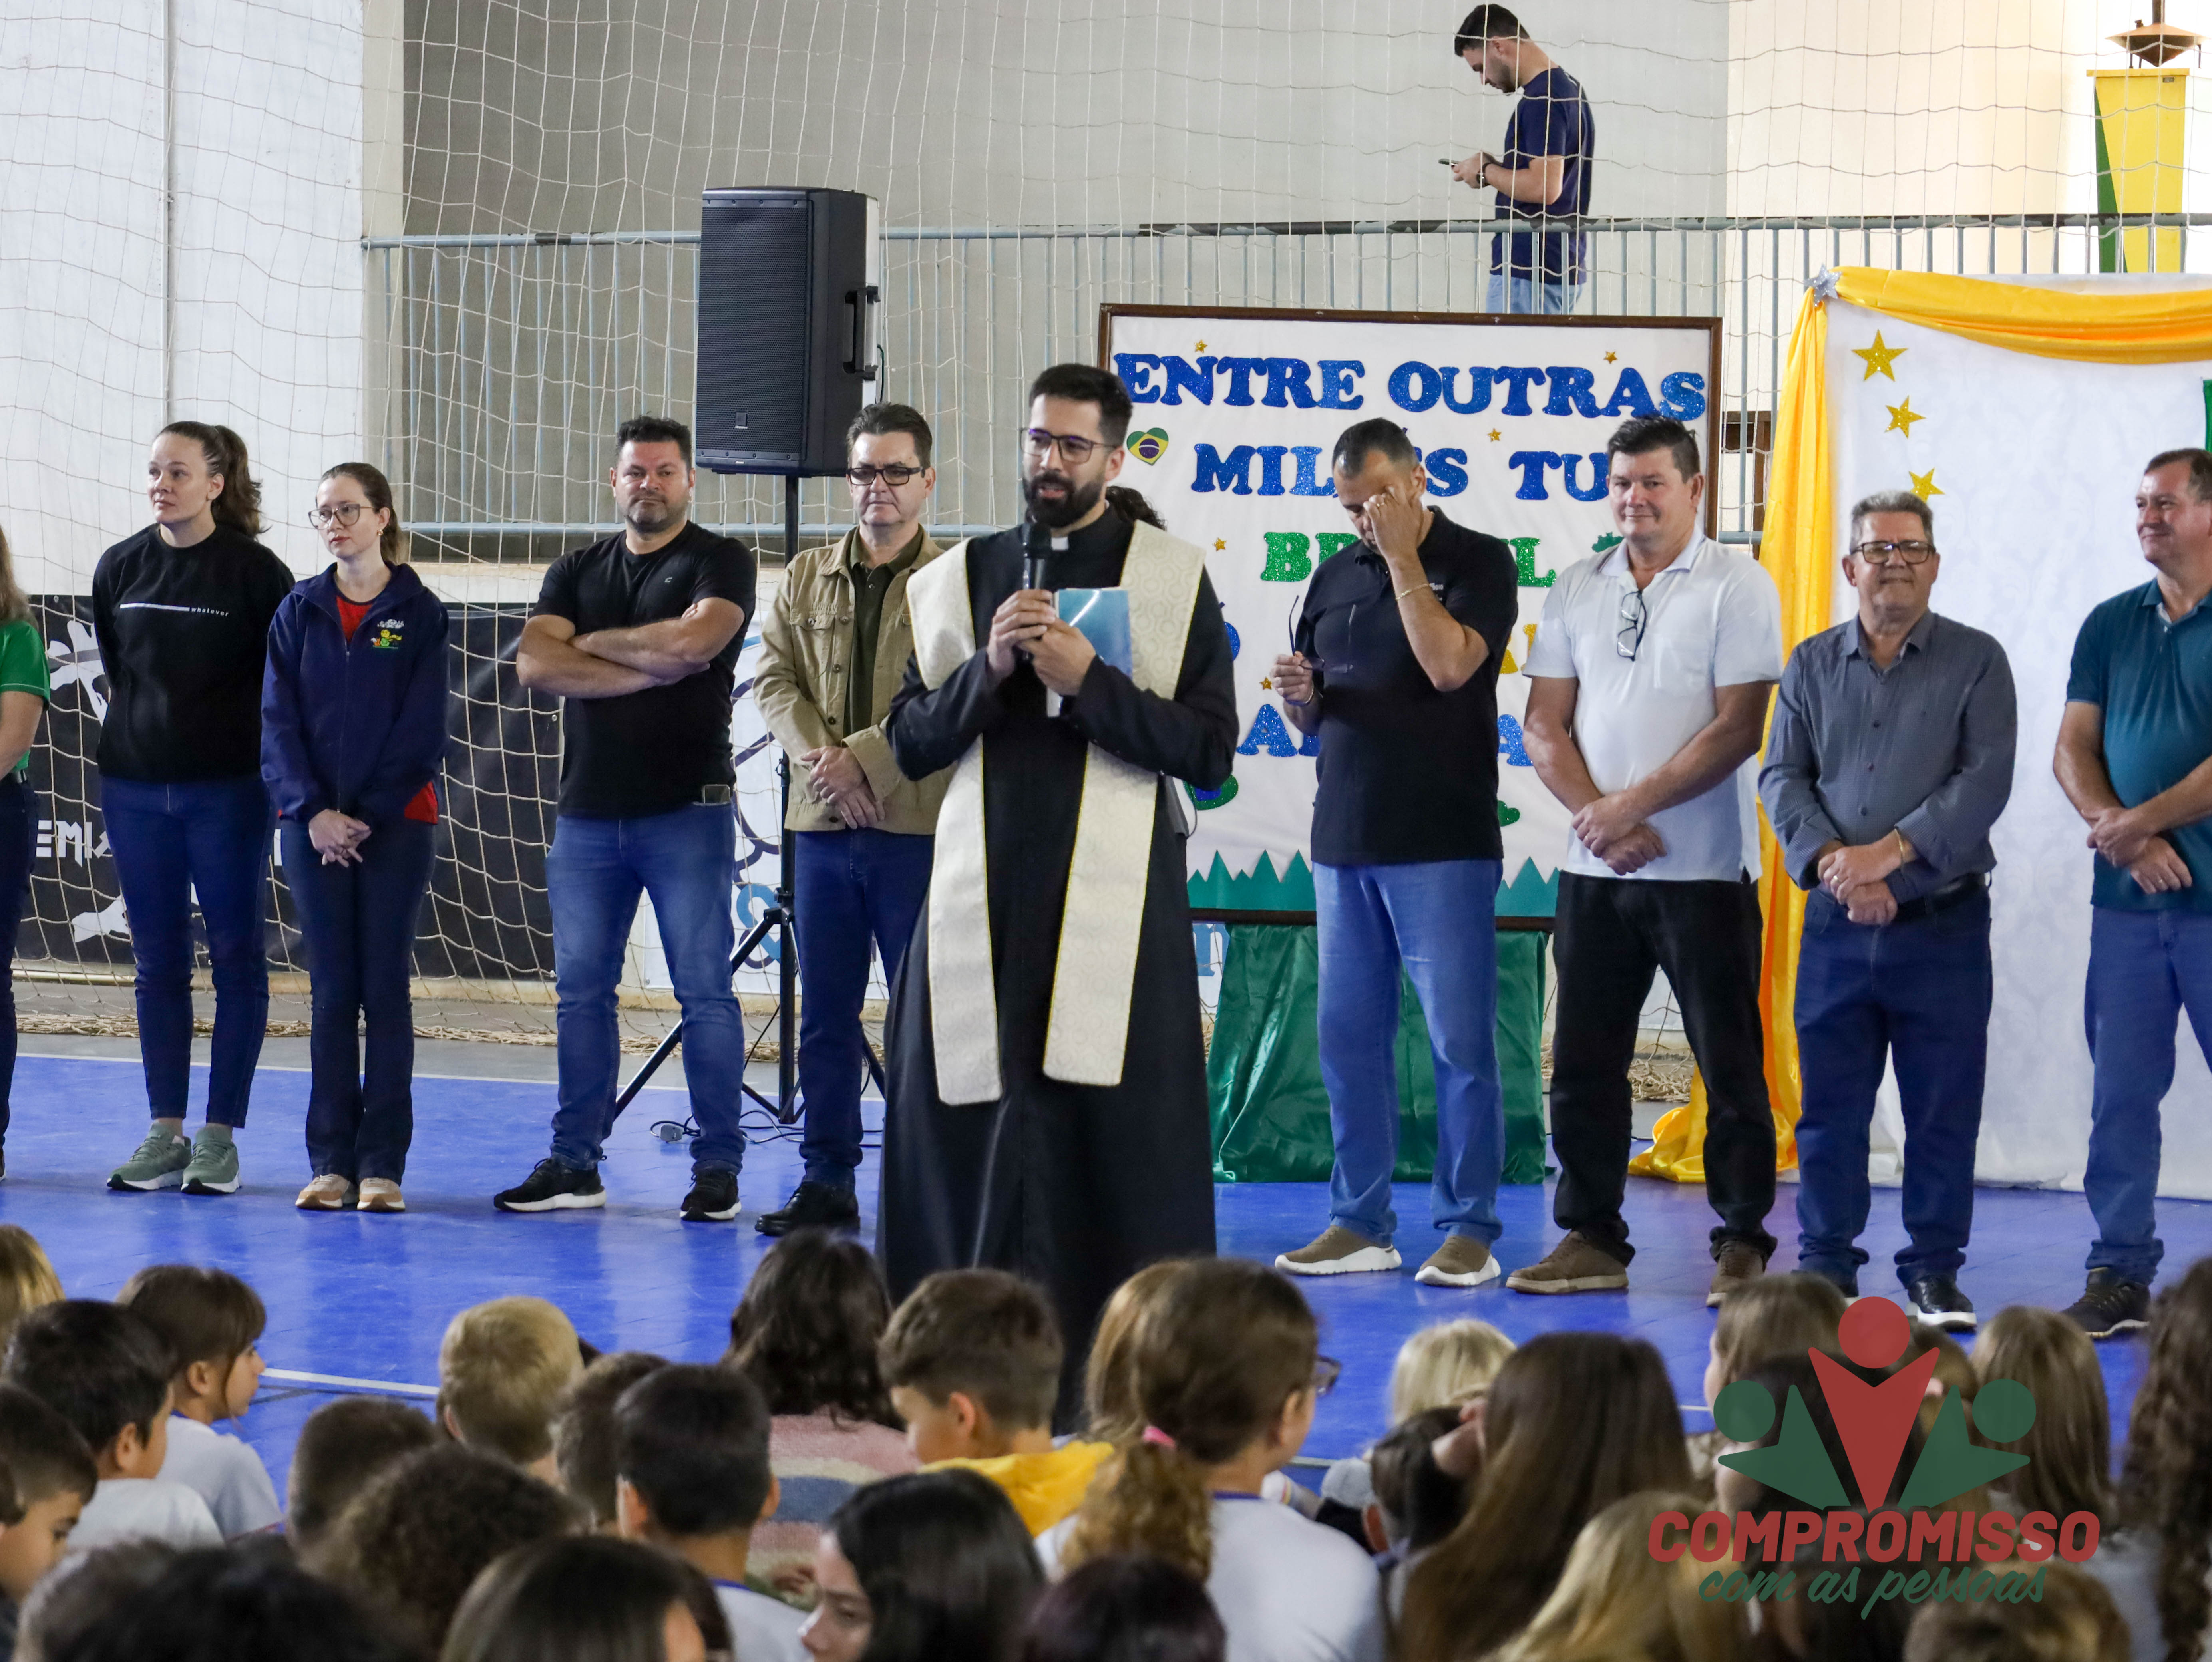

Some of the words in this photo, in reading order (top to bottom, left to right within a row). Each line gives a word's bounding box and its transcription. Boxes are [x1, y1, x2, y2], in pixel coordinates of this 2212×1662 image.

[1114, 353, 1365, 410] ENTRE
[1388, 361, 1705, 421] OUTRAS
[1191, 443, 1338, 498] MIL
[1509, 451, 1609, 501] TU
[191, 607, 229, 616] whatever
